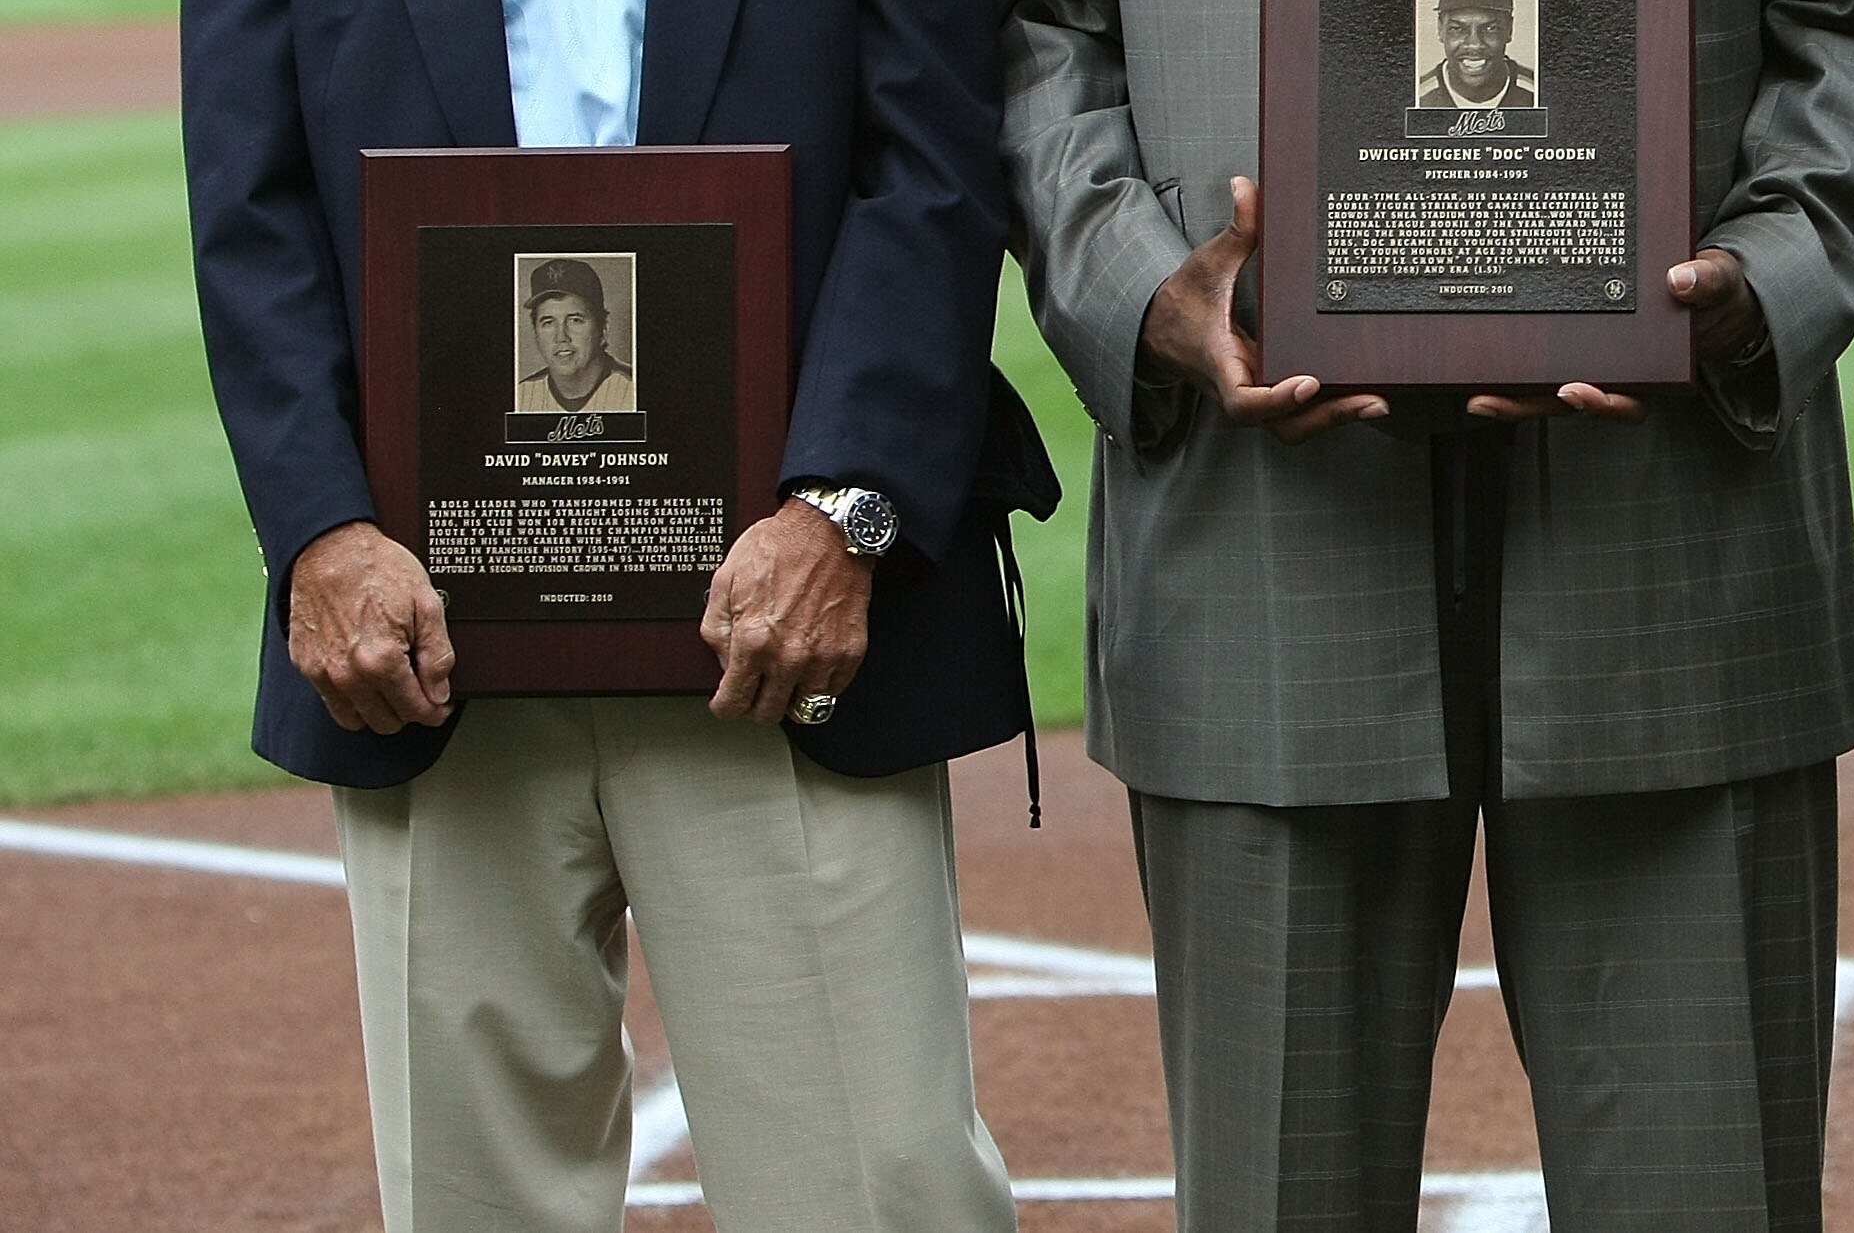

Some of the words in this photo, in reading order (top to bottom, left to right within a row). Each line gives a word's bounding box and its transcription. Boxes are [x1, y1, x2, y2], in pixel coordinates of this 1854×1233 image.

[1448, 109, 1506, 137] Mets
[1359, 149, 1419, 160] DWIGHT
[1423, 149, 1481, 160] EUGENE
[1534, 148, 1595, 160] GOODEN
[1425, 170, 1471, 178] PITCHER
[1473, 170, 1528, 178] 1984-1995
[1327, 193, 1335, 201] A
[1340, 193, 1400, 201] FOUR-TIME
[1328, 202, 1370, 210] DOUBLE
[1376, 202, 1415, 210] FIGURE
[1328, 220, 1380, 228] NATIONAL
[1385, 220, 1425, 228] LEAGUE
[1430, 220, 1469, 228] ROOKIE
[1464, 238, 1521, 246] YOUNGEST
[1526, 238, 1573, 246] PITCHER
[1579, 238, 1606, 246] EVER
[1458, 247, 1470, 255] AT
[1475, 247, 1495, 255] AGE
[1500, 247, 1513, 255] 20
[1518, 247, 1548, 255] WHEN
[1553, 247, 1566, 255] HE
[1572, 247, 1625, 255] CAPTURED
[547, 413, 604, 442] Mets
[485, 455, 530, 466] DAVID
[601, 454, 668, 467] JOHNSON
[522, 477, 574, 485] MANAGER
[577, 476, 629, 484] 1984-1991
[429, 500, 435, 508] A
[441, 500, 469, 508] BOLD
[552, 499, 632, 507] TRANSFORMED
[547, 518, 565, 526] 108
[570, 518, 618, 526] REGULAR
[429, 528, 465, 536] ROUTE
[429, 537, 476, 545] FINISHED
[631, 536, 654, 544] BEST
[586, 555, 614, 563] THAN
[540, 594, 589, 602] INDUCTED:
